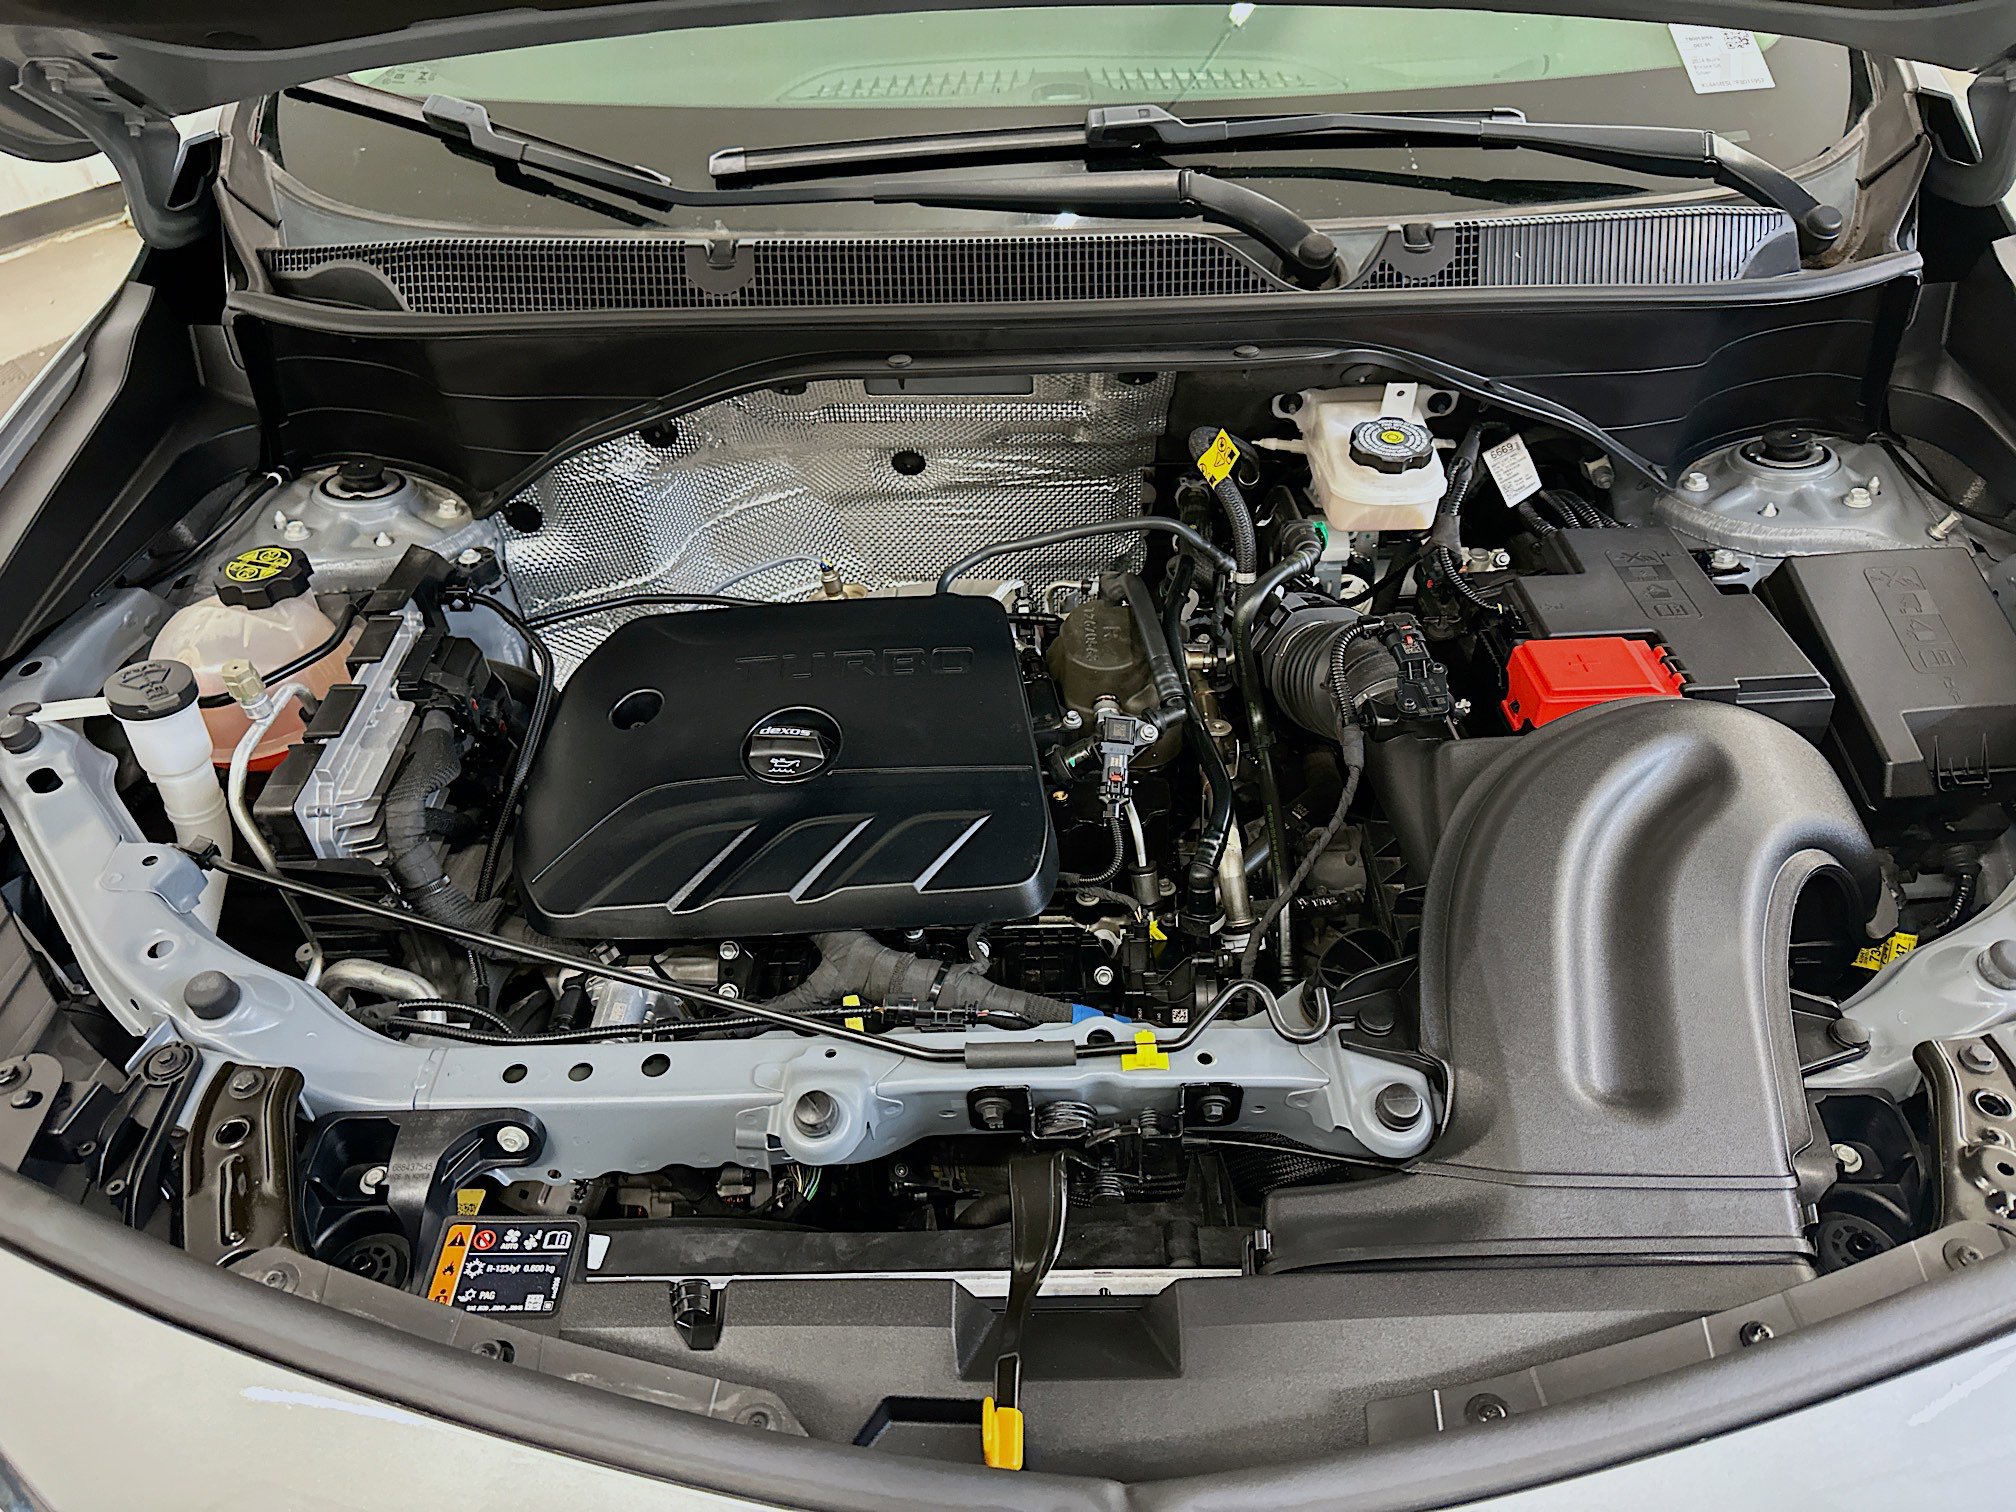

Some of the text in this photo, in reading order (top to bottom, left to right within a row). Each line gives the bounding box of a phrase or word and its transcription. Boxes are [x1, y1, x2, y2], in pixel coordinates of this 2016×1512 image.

[735, 647, 975, 680] TURBO
[759, 726, 812, 737] dexos
[486, 1264, 521, 1274] R-1234yf
[546, 1264, 556, 1274] kg
[478, 1291, 496, 1300] PAG
